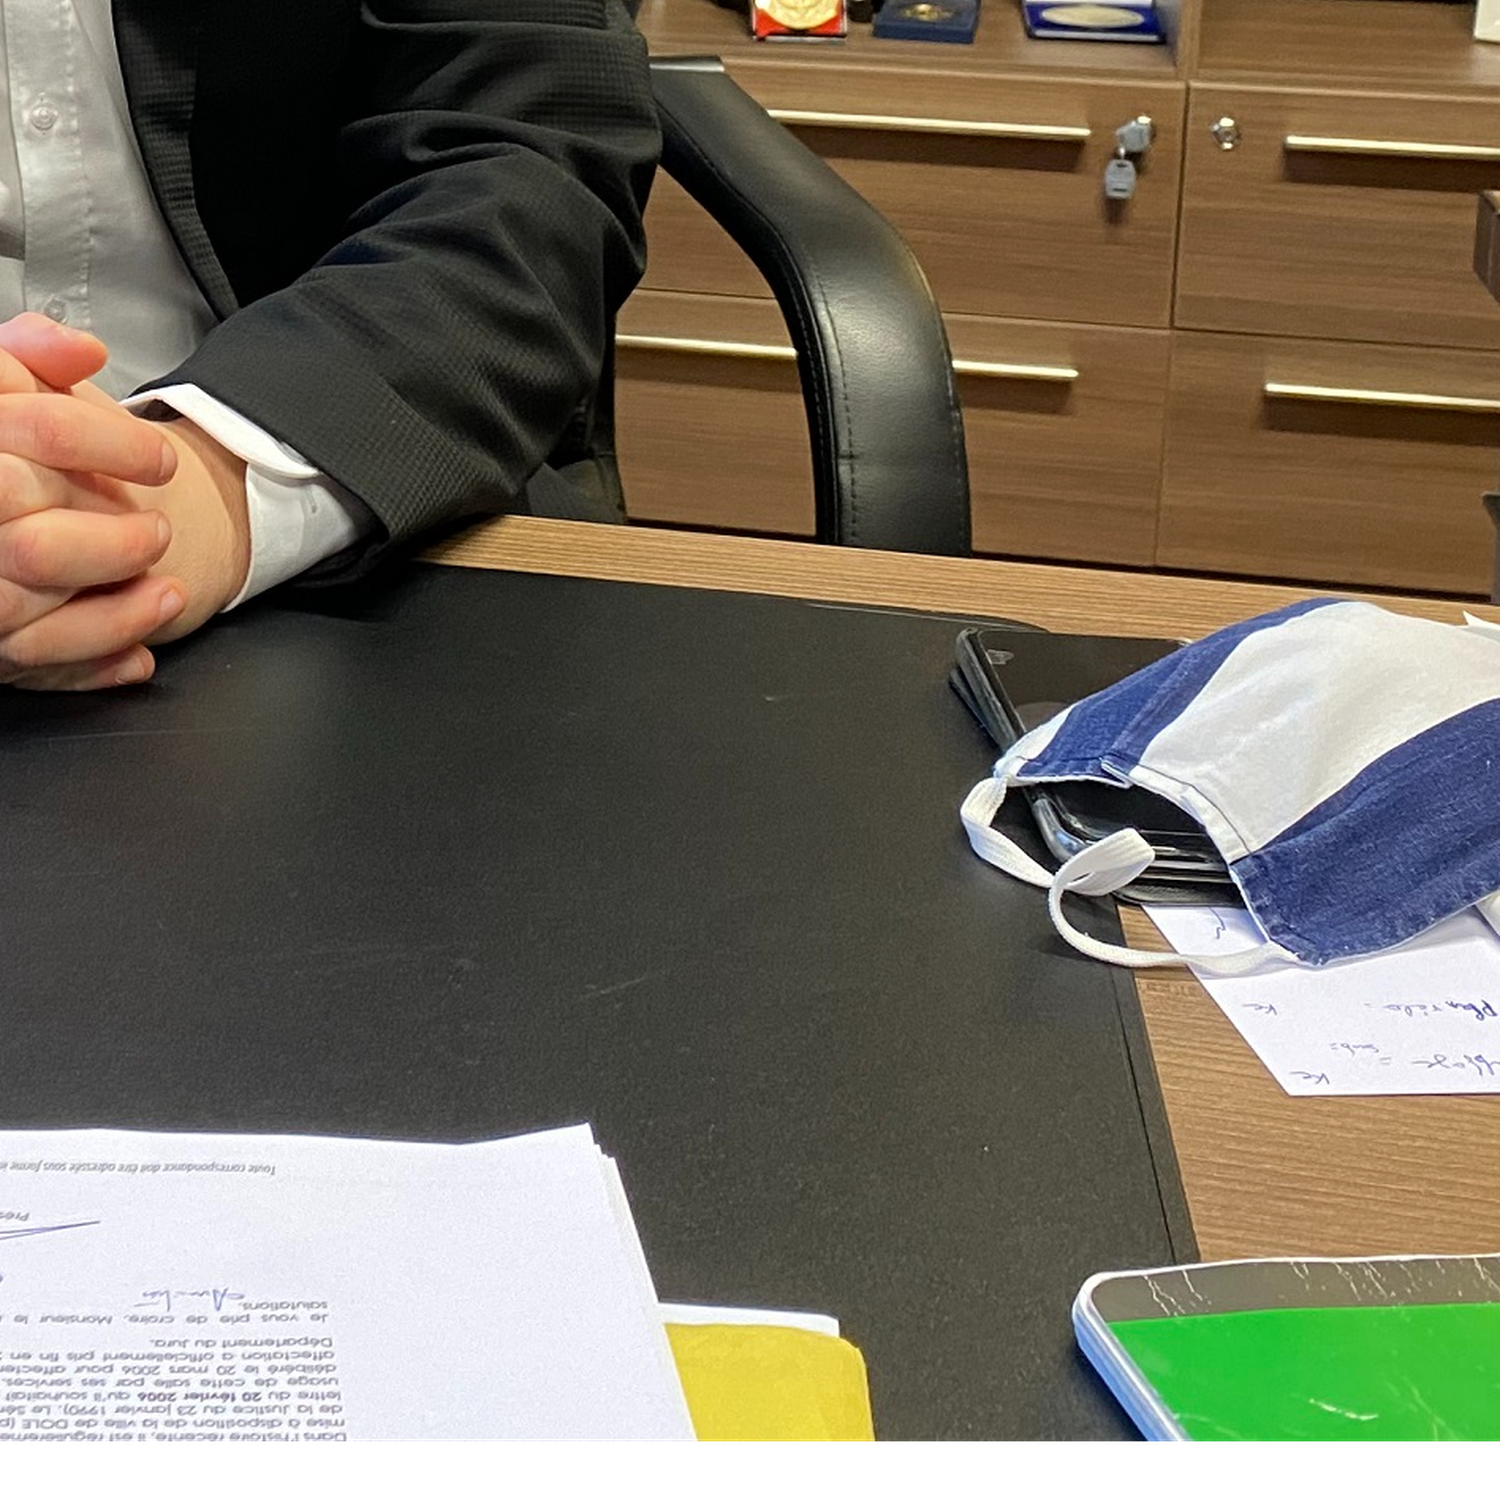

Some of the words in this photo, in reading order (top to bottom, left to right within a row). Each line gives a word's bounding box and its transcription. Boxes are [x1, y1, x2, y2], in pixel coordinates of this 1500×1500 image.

[239, 1301, 328, 1311] salutations.
[14, 1315, 28, 1324] le
[40, 1315, 112, 1324] Monsieur
[124, 1314, 174, 1324] croire,
[186, 1315, 208, 1324] de
[220, 1313, 250, 1324] prie
[261, 1314, 298, 1322] vous
[310, 1314, 329, 1323] Je
[150, 1339, 190, 1349] Jura.
[195, 1340, 217, 1349] du
[222, 1337, 332, 1348] Département
[10, 1352, 32, 1360] en
[39, 1353, 59, 1361] fin
[67, 1351, 95, 1361] pris
[103, 1352, 214, 1361] officiellement
[222, 1352, 234, 1360] a
[242, 1351, 334, 1361] affectation
[75, 1364, 114, 1374] pour
[121, 1365, 161, 1375] 2006
[169, 1365, 208, 1374] mars
[216, 1365, 236, 1375] 20
[244, 1365, 258, 1374] le
[267, 1364, 336, 1374] délibéré
[1, 1378, 72, 1387] services.
[81, 1379, 106, 1387] ses
[115, 1377, 145, 1387] par
[154, 1379, 190, 1388] salle
[200, 1379, 245, 1387] cette
[254, 1378, 278, 1388] de
[288, 1376, 338, 1387] usage
[6, 1392, 88, 1401] souhaitait
[138, 1392, 177, 1401] 2006
[183, 1392, 236, 1402] février
[242, 1392, 262, 1401] 20
[269, 1392, 291, 1401] du
[298, 1391, 340, 1401] lettre
[32, 1406, 51, 1414] Le
[59, 1404, 105, 1415] 1990).
[115, 1404, 172, 1415] janvier
[177, 1406, 197, 1415] 23
[203, 1406, 226, 1415] du
[233, 1406, 290, 1415] Justice
[298, 1405, 312, 1415] la
[320, 1405, 343, 1415] de
[22, 1419, 69, 1429] DOLE
[75, 1419, 98, 1429] de
[104, 1419, 136, 1429] ville
[143, 1419, 158, 1429] la
[164, 1419, 187, 1428] de
[193, 1418, 282, 1429] disposition
[288, 1419, 300, 1429] à
[307, 1419, 345, 1427] mise
